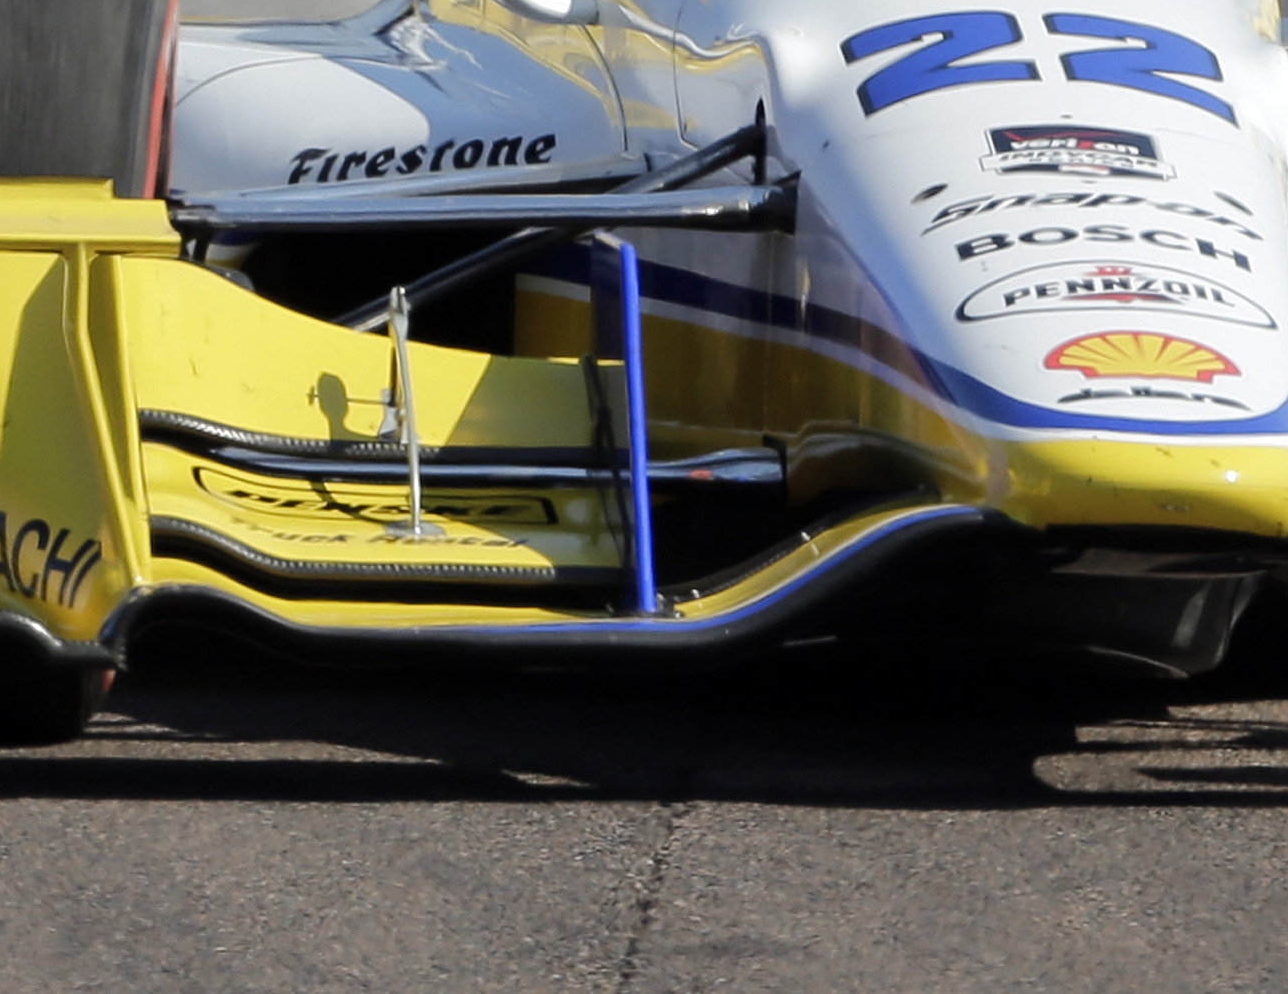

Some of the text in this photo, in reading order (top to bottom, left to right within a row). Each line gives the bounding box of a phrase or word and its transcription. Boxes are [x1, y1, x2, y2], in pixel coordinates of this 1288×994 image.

[841, 9, 1239, 128] 22
[287, 133, 557, 185] Firestone
[955, 224, 1252, 273] BOSCH
[1003, 277, 1236, 307] PENNZOIL
